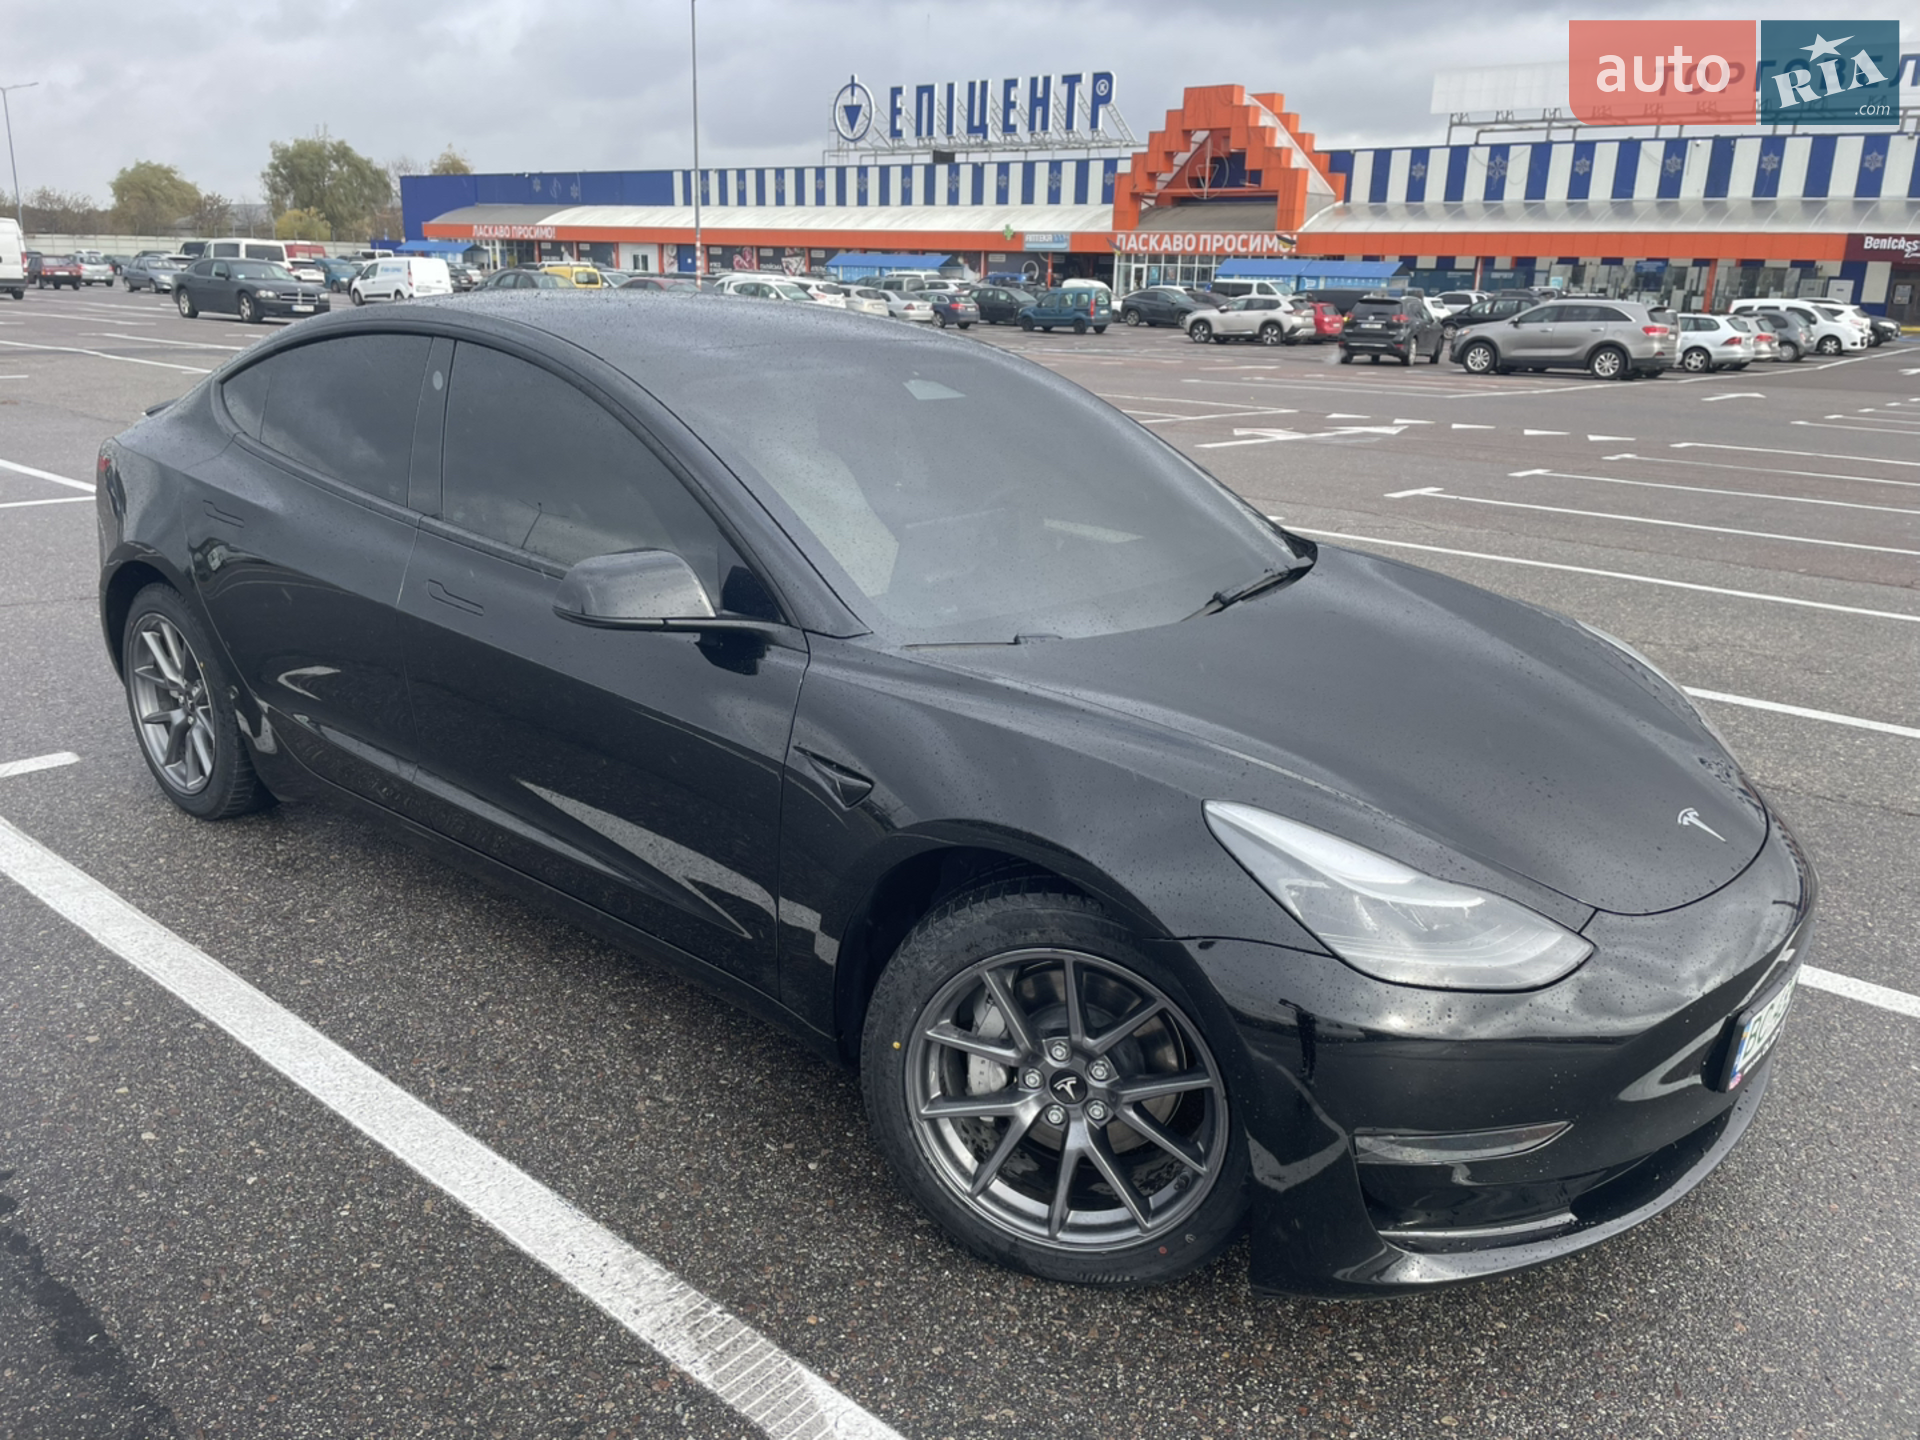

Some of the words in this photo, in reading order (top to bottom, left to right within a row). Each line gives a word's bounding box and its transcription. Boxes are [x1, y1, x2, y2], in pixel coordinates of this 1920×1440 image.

[889, 71, 1117, 140] ЕПІЦЕНТР
[472, 224, 510, 238] ЛАСКАВО
[511, 226, 556, 239] ПРОСИМО!
